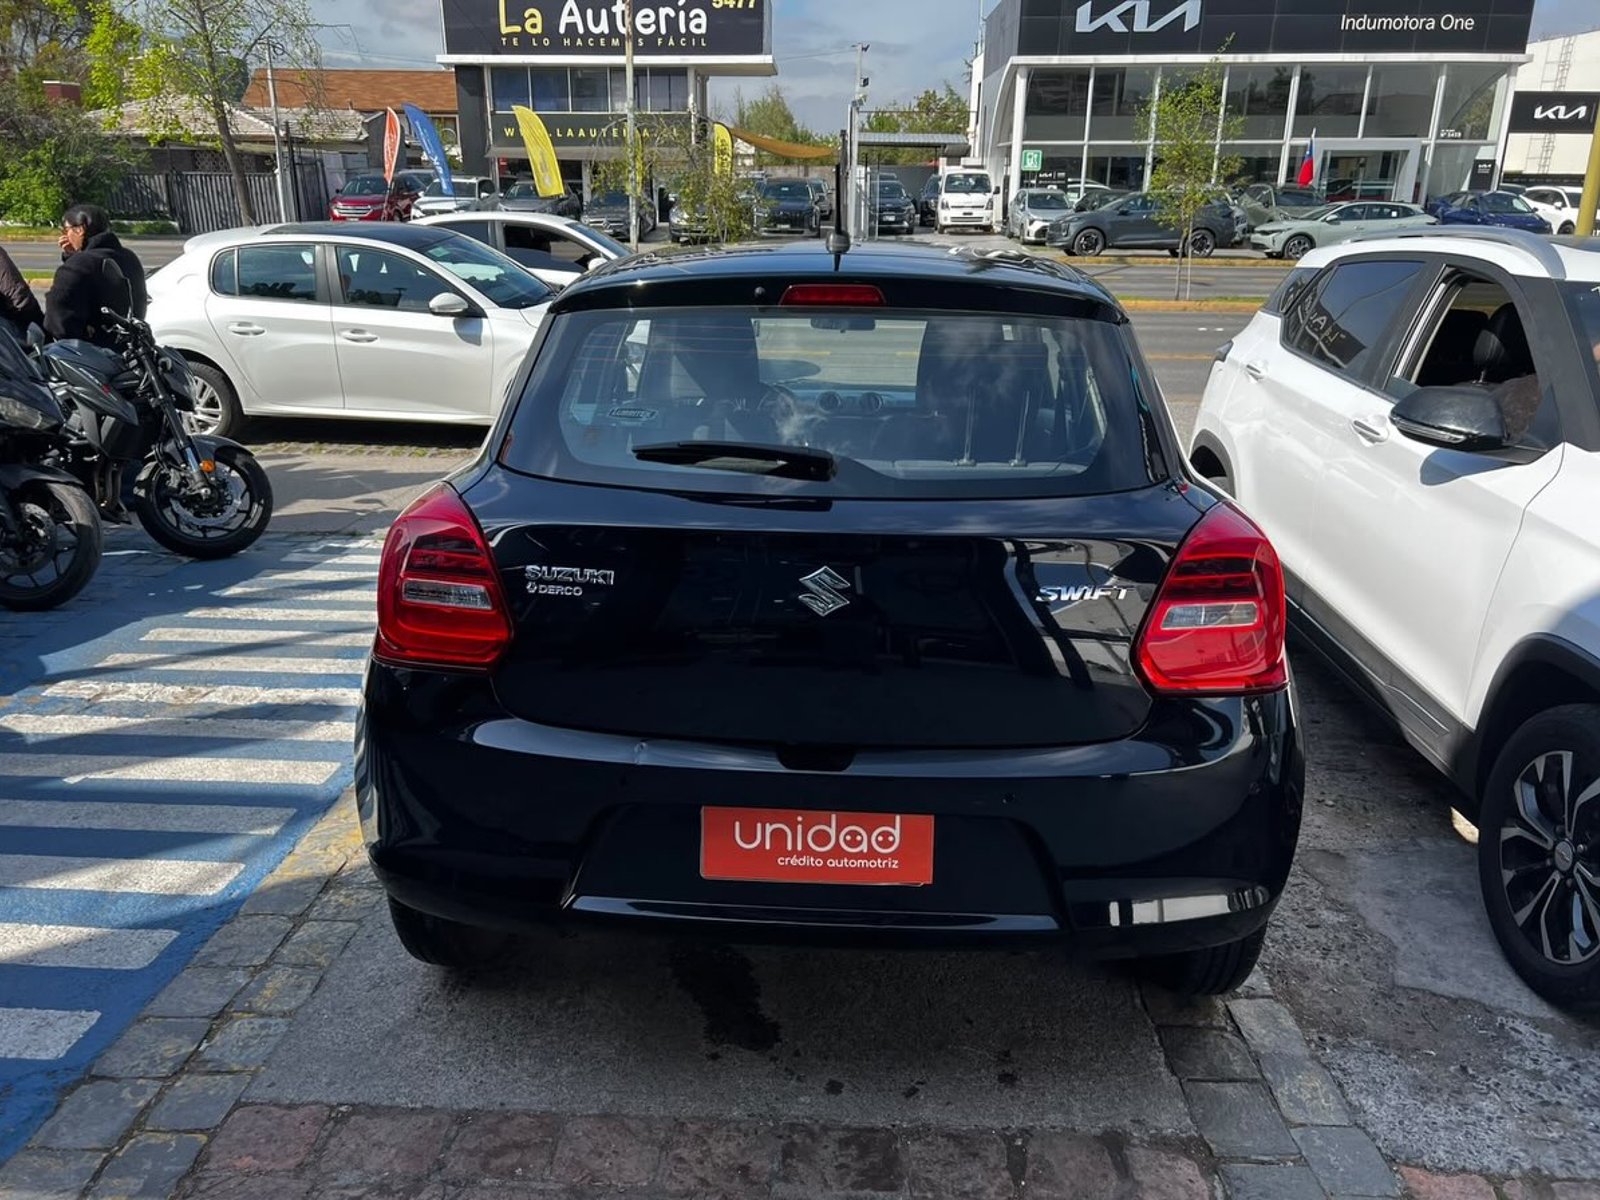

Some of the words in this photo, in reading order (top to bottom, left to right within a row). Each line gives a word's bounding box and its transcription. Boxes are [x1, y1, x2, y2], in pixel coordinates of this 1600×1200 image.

[499, 0, 543, 34] La
[1075, 0, 1201, 32] KIA
[1340, 14, 1436, 31] Indumotora
[1440, 14, 1475, 31] One
[501, 37, 519, 47] TE
[532, 37, 551, 47] LO
[563, 37, 645, 47] HACEMS
[657, 35, 707, 47] FÁCIL
[1533, 105, 1588, 119] KIA
[525, 564, 615, 585] SUZUKI
[538, 584, 583, 597] DERCO
[1035, 583, 1135, 602] SWIFT
[734, 813, 901, 854] unidad
[777, 853, 824, 867] crédito
[826, 856, 900, 869] automotriz
